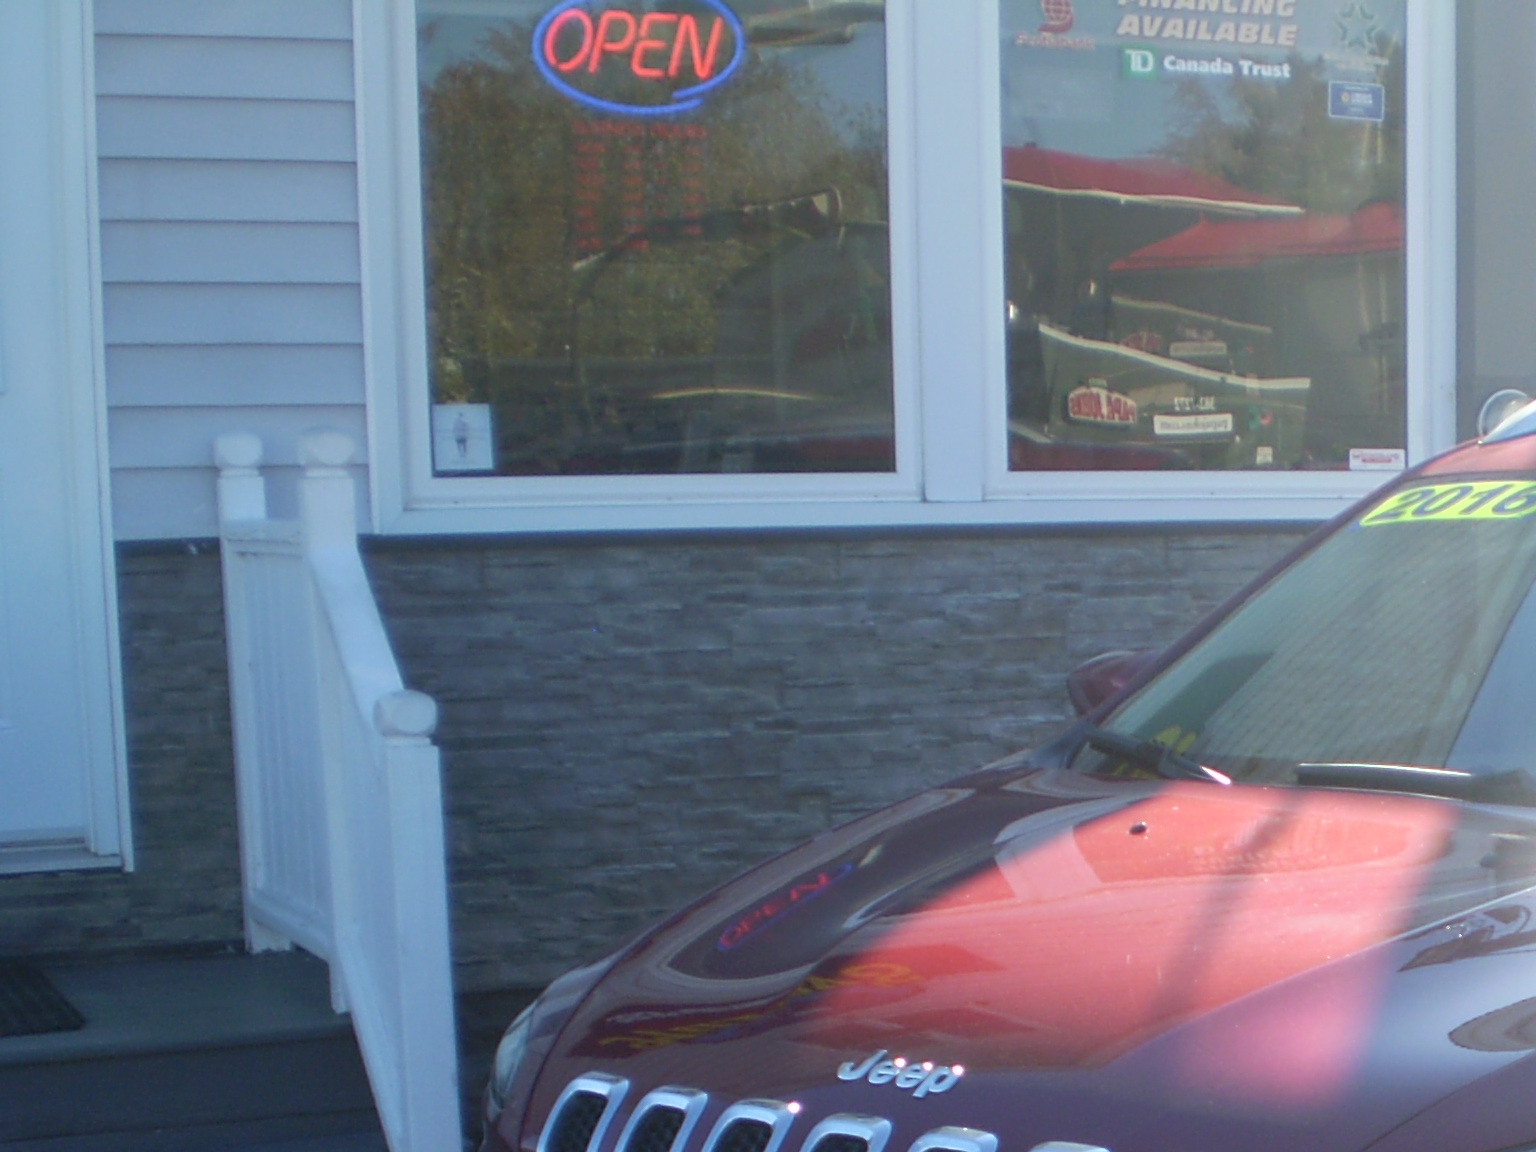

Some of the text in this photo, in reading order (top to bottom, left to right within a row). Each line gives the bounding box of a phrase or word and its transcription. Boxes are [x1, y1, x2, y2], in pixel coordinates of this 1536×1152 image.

[543, 6, 723, 79] OPEN
[1116, 14, 1298, 47] AVAILABLE
[1125, 49, 1292, 79] TD Canada Trust
[837, 1049, 965, 1098] Jeep
